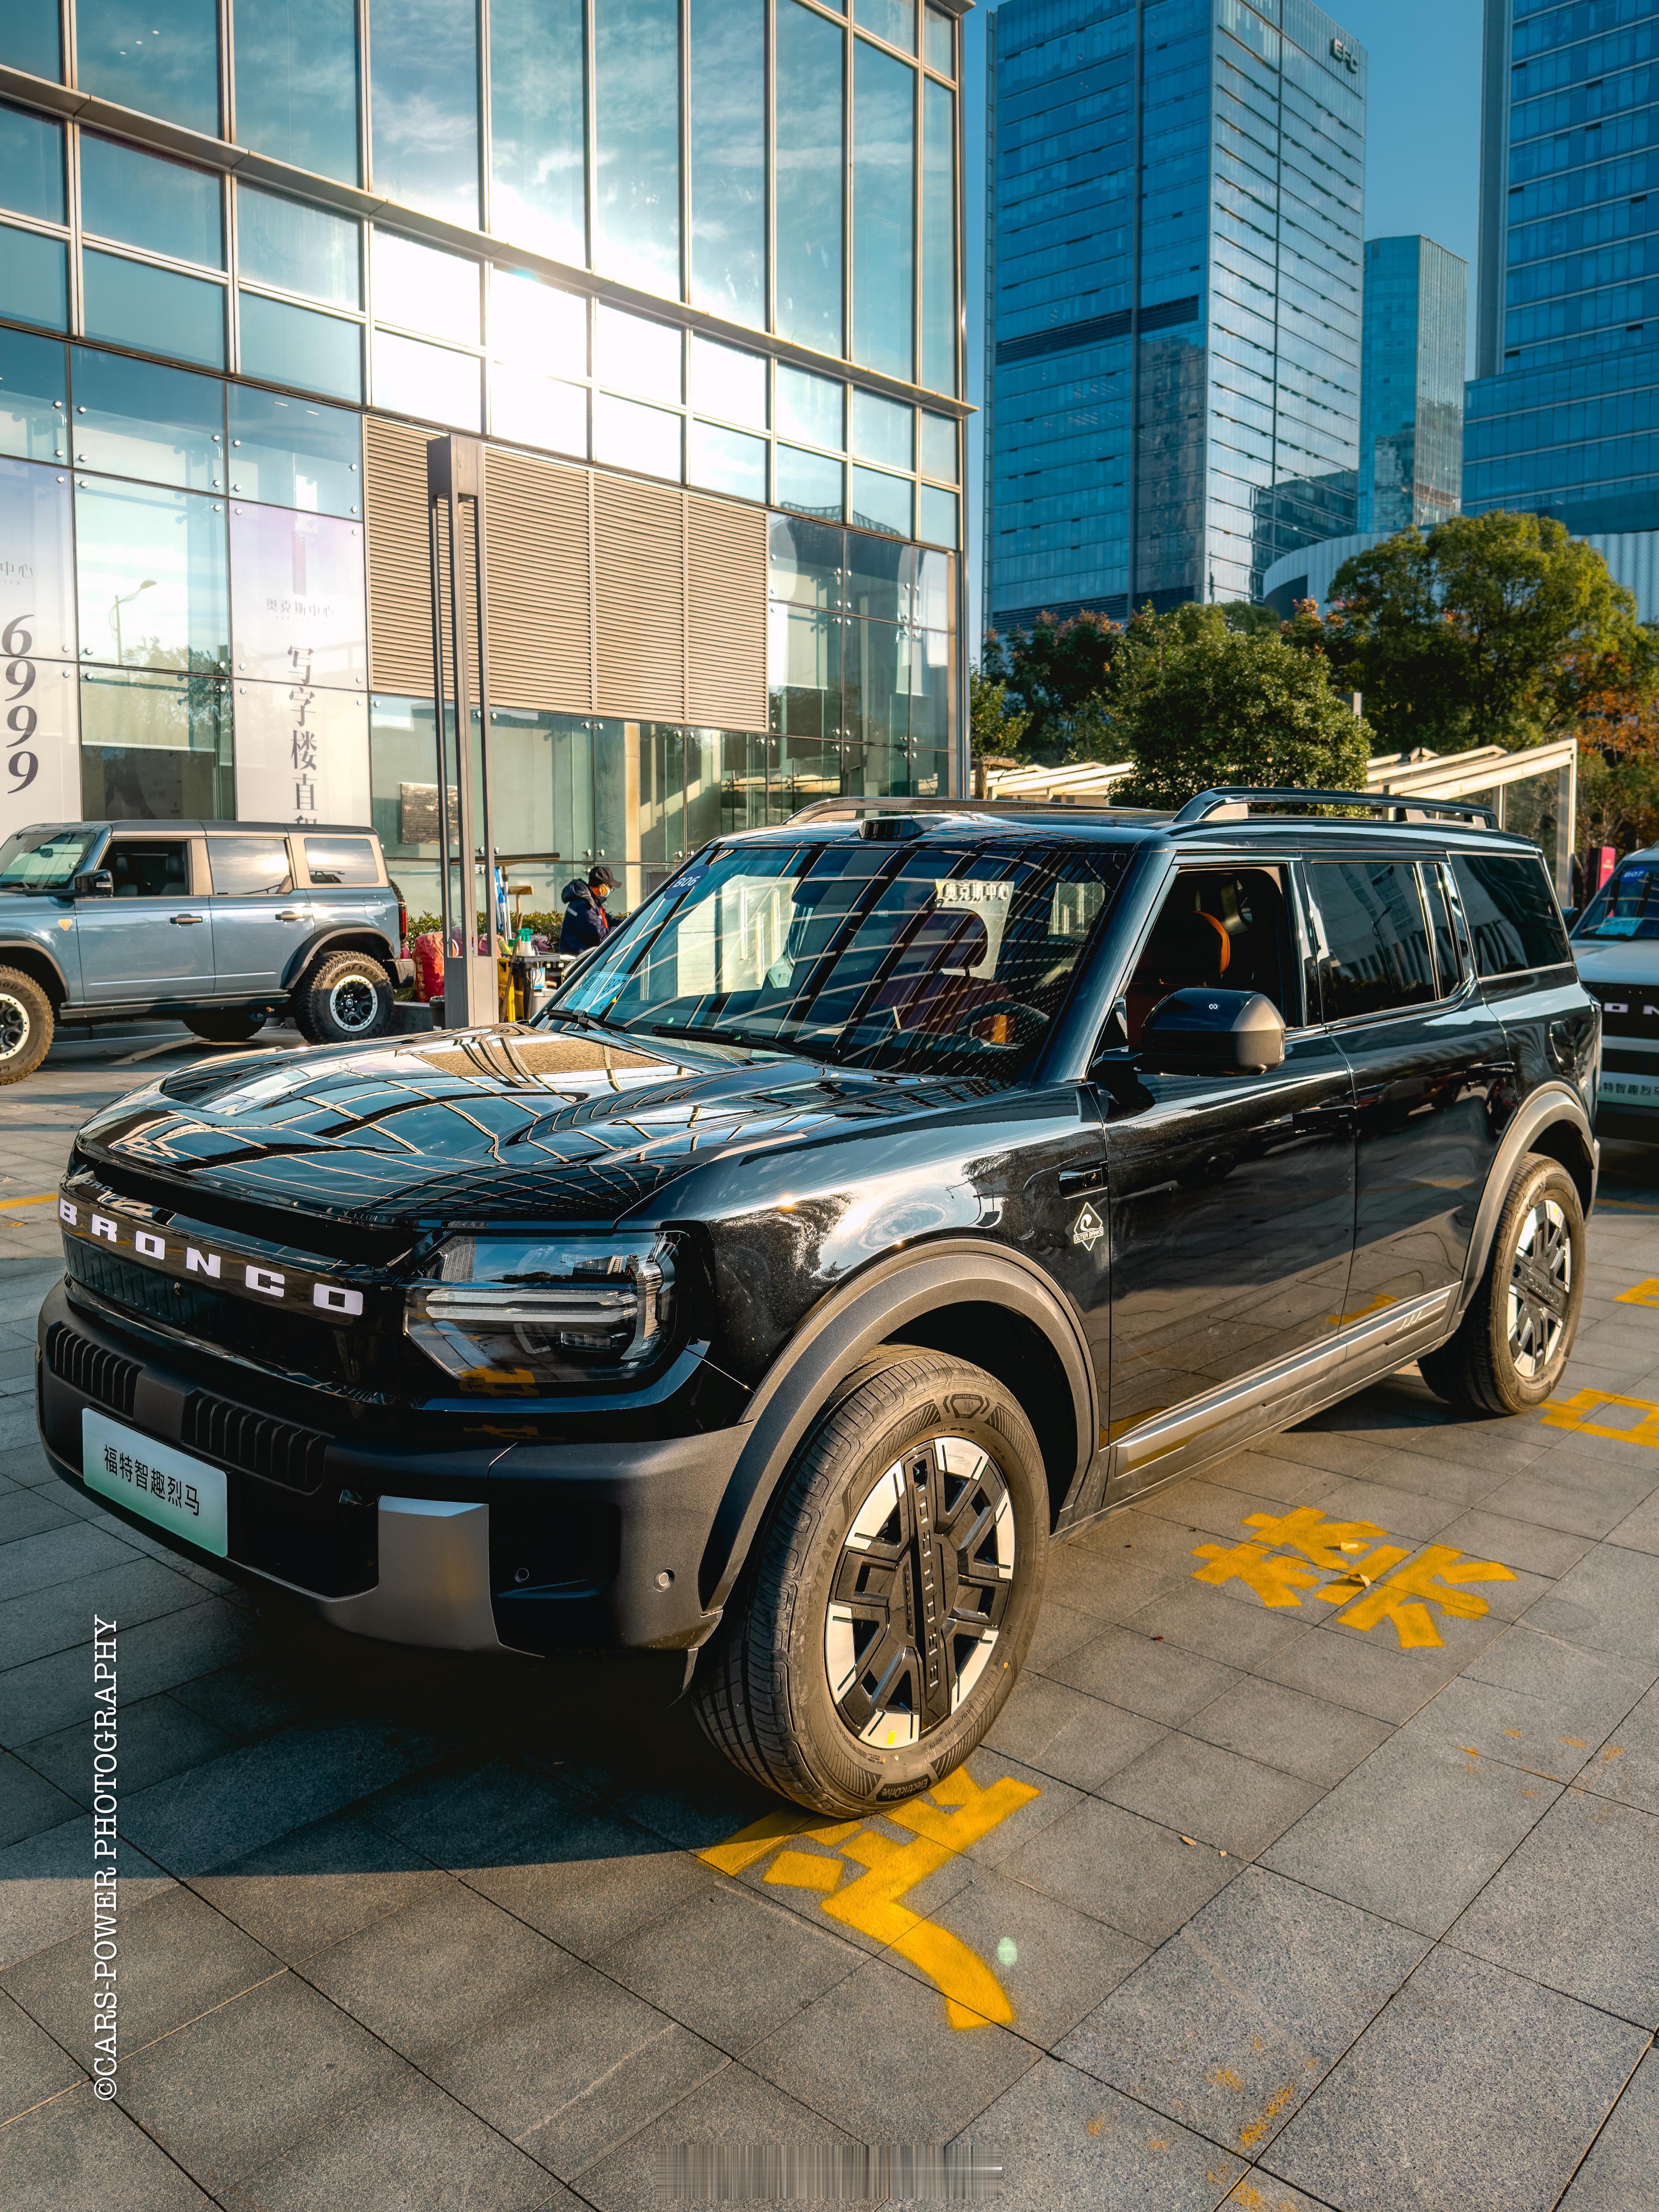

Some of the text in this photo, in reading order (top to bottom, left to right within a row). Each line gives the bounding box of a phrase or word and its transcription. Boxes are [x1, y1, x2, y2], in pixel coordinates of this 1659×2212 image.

[1331, 38, 1359, 74] EFC
[266, 598, 334, 618] 奥克斯中心
[672, 876, 701, 888] B06
[1599, 1082, 1659, 1097] 特智趣烈马
[1075, 1229, 1102, 1242] OUTER BANKS
[60, 1198, 364, 1316] BRONCO
[104, 1444, 199, 1516] 福特智趣烈马
[882, 1778, 928, 1798] ElectricDrive
